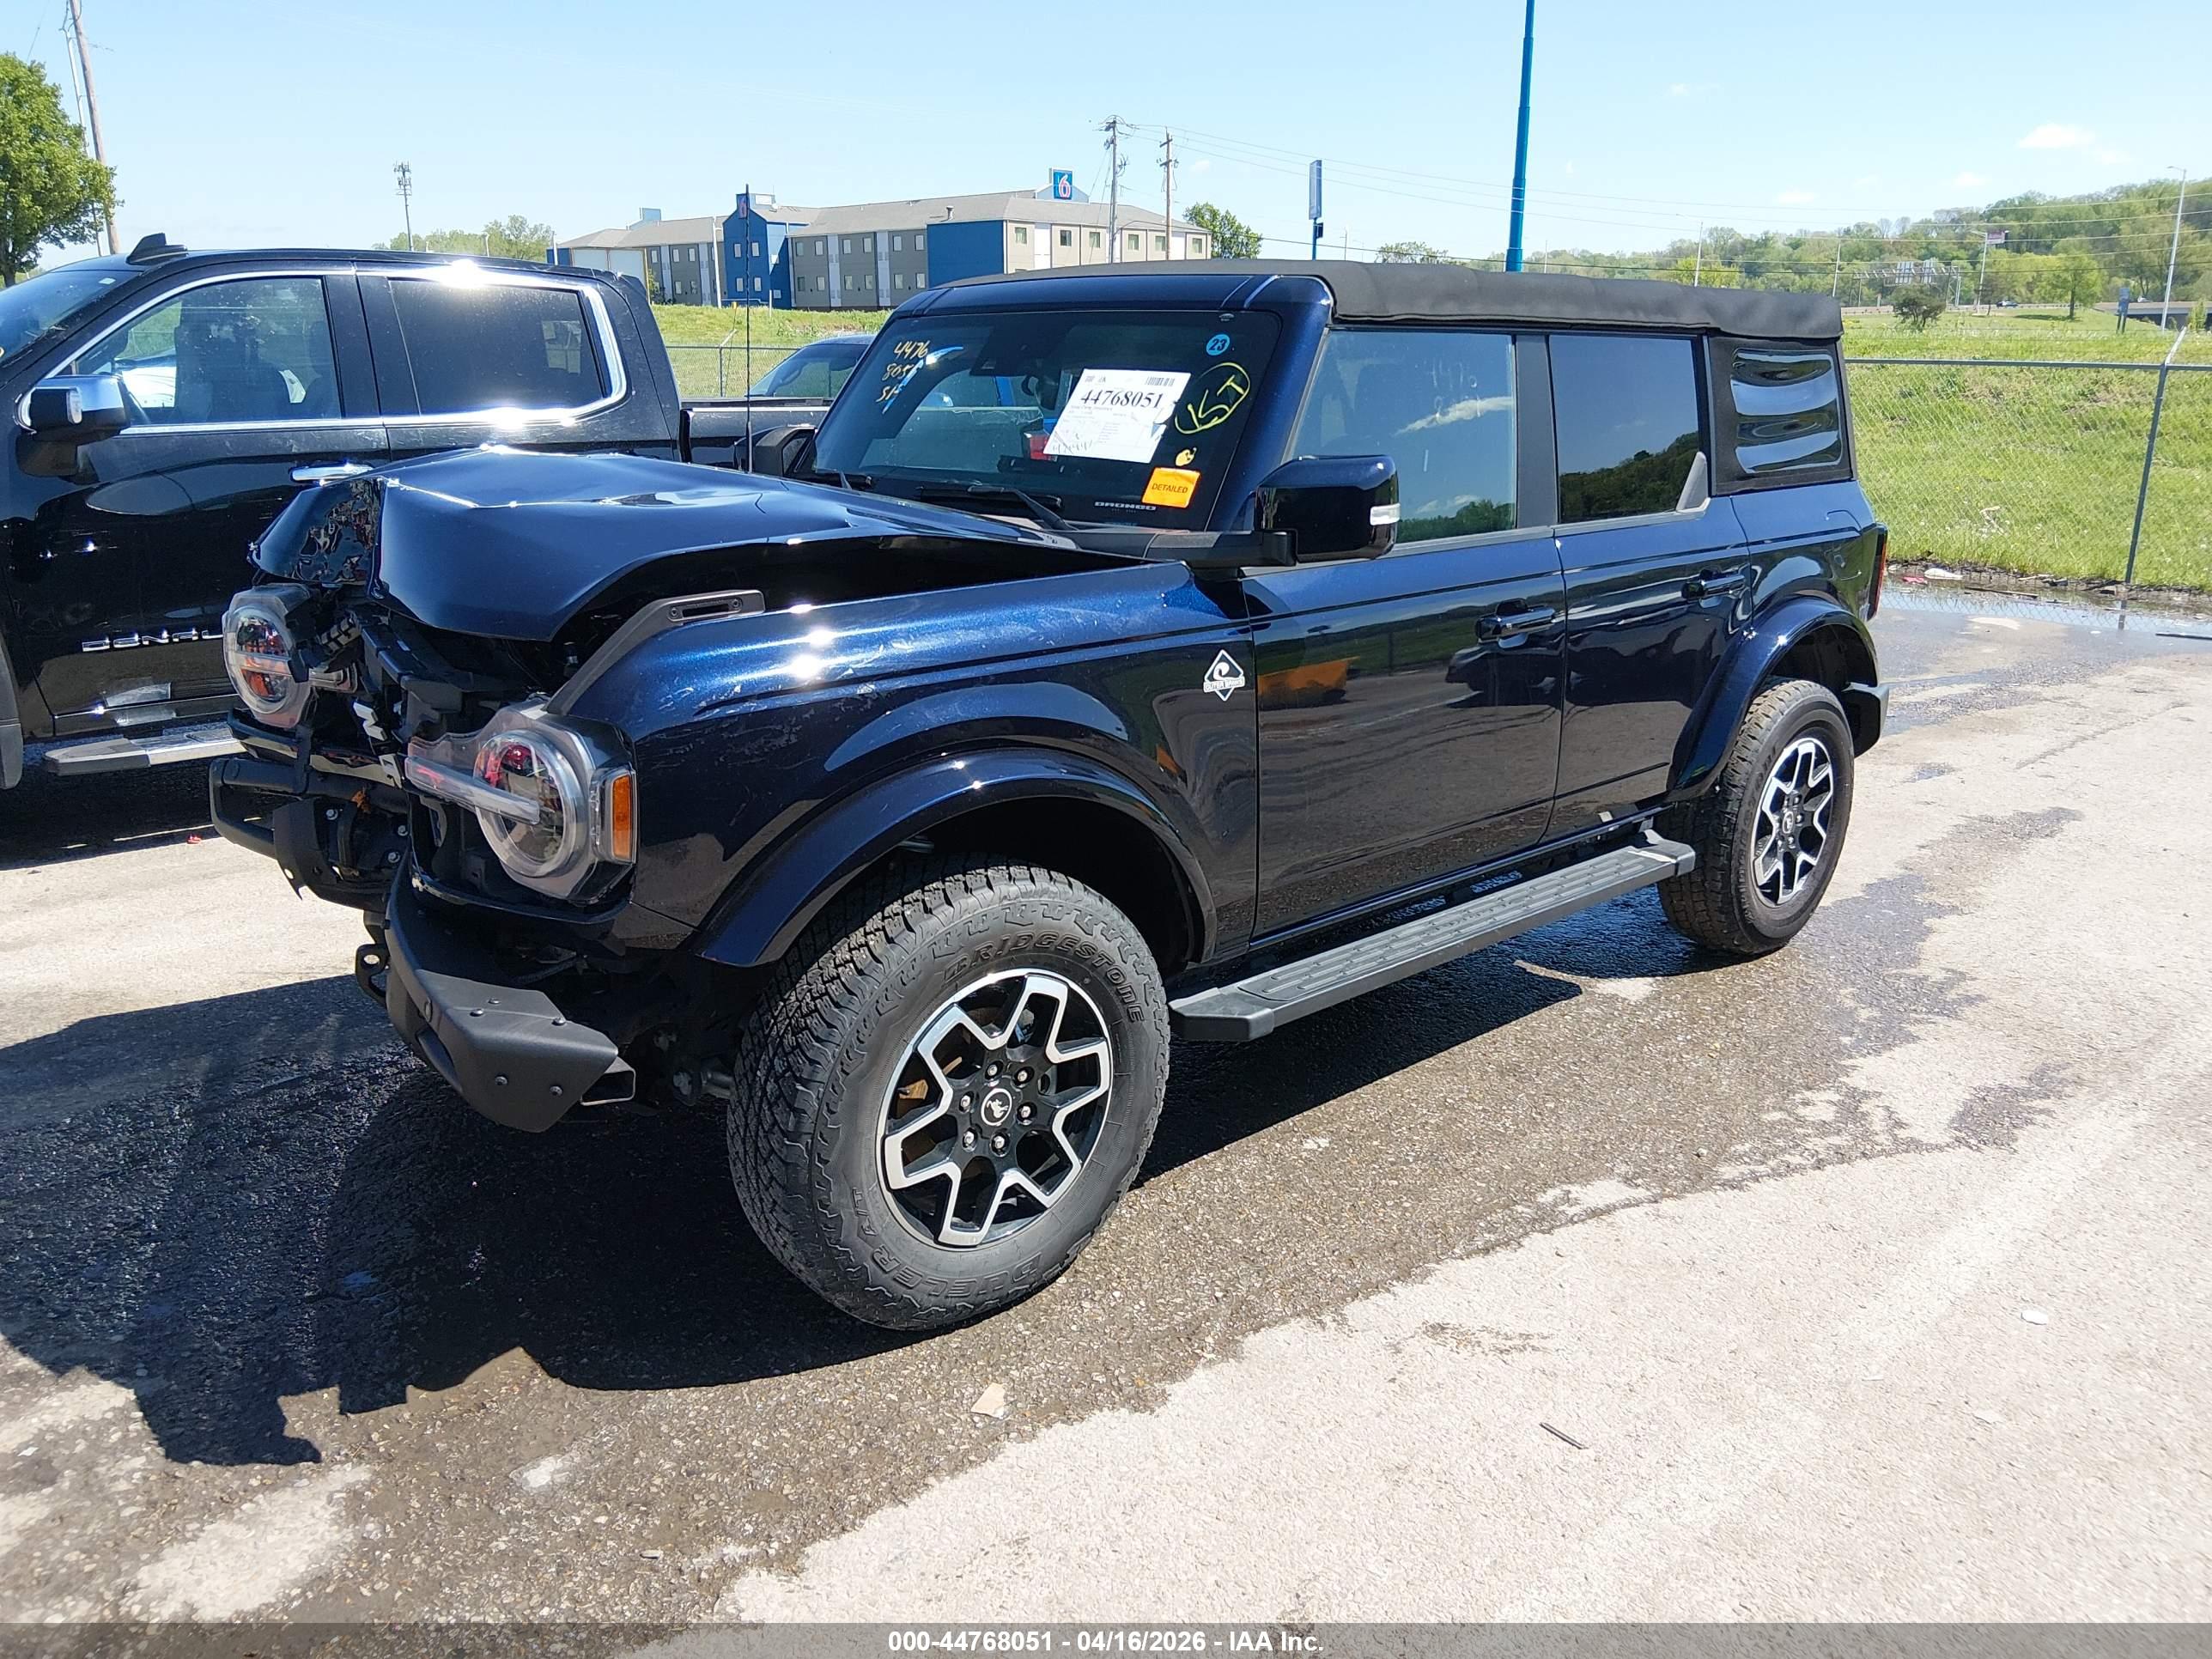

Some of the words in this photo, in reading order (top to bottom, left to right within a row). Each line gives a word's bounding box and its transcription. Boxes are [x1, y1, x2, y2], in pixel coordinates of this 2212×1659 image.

[1059, 173, 1071, 198] 6
[894, 340, 931, 360] 4476
[1209, 338, 1227, 351] 23
[1080, 389, 1164, 409] 44768051
[1152, 483, 1188, 494] DETAILED
[1094, 501, 1157, 512] BRONCO
[82, 629, 224, 652] DENAL
[944, 930, 1146, 1024] BRIDGESTONE
[872, 1245, 1042, 1298] DUELER
